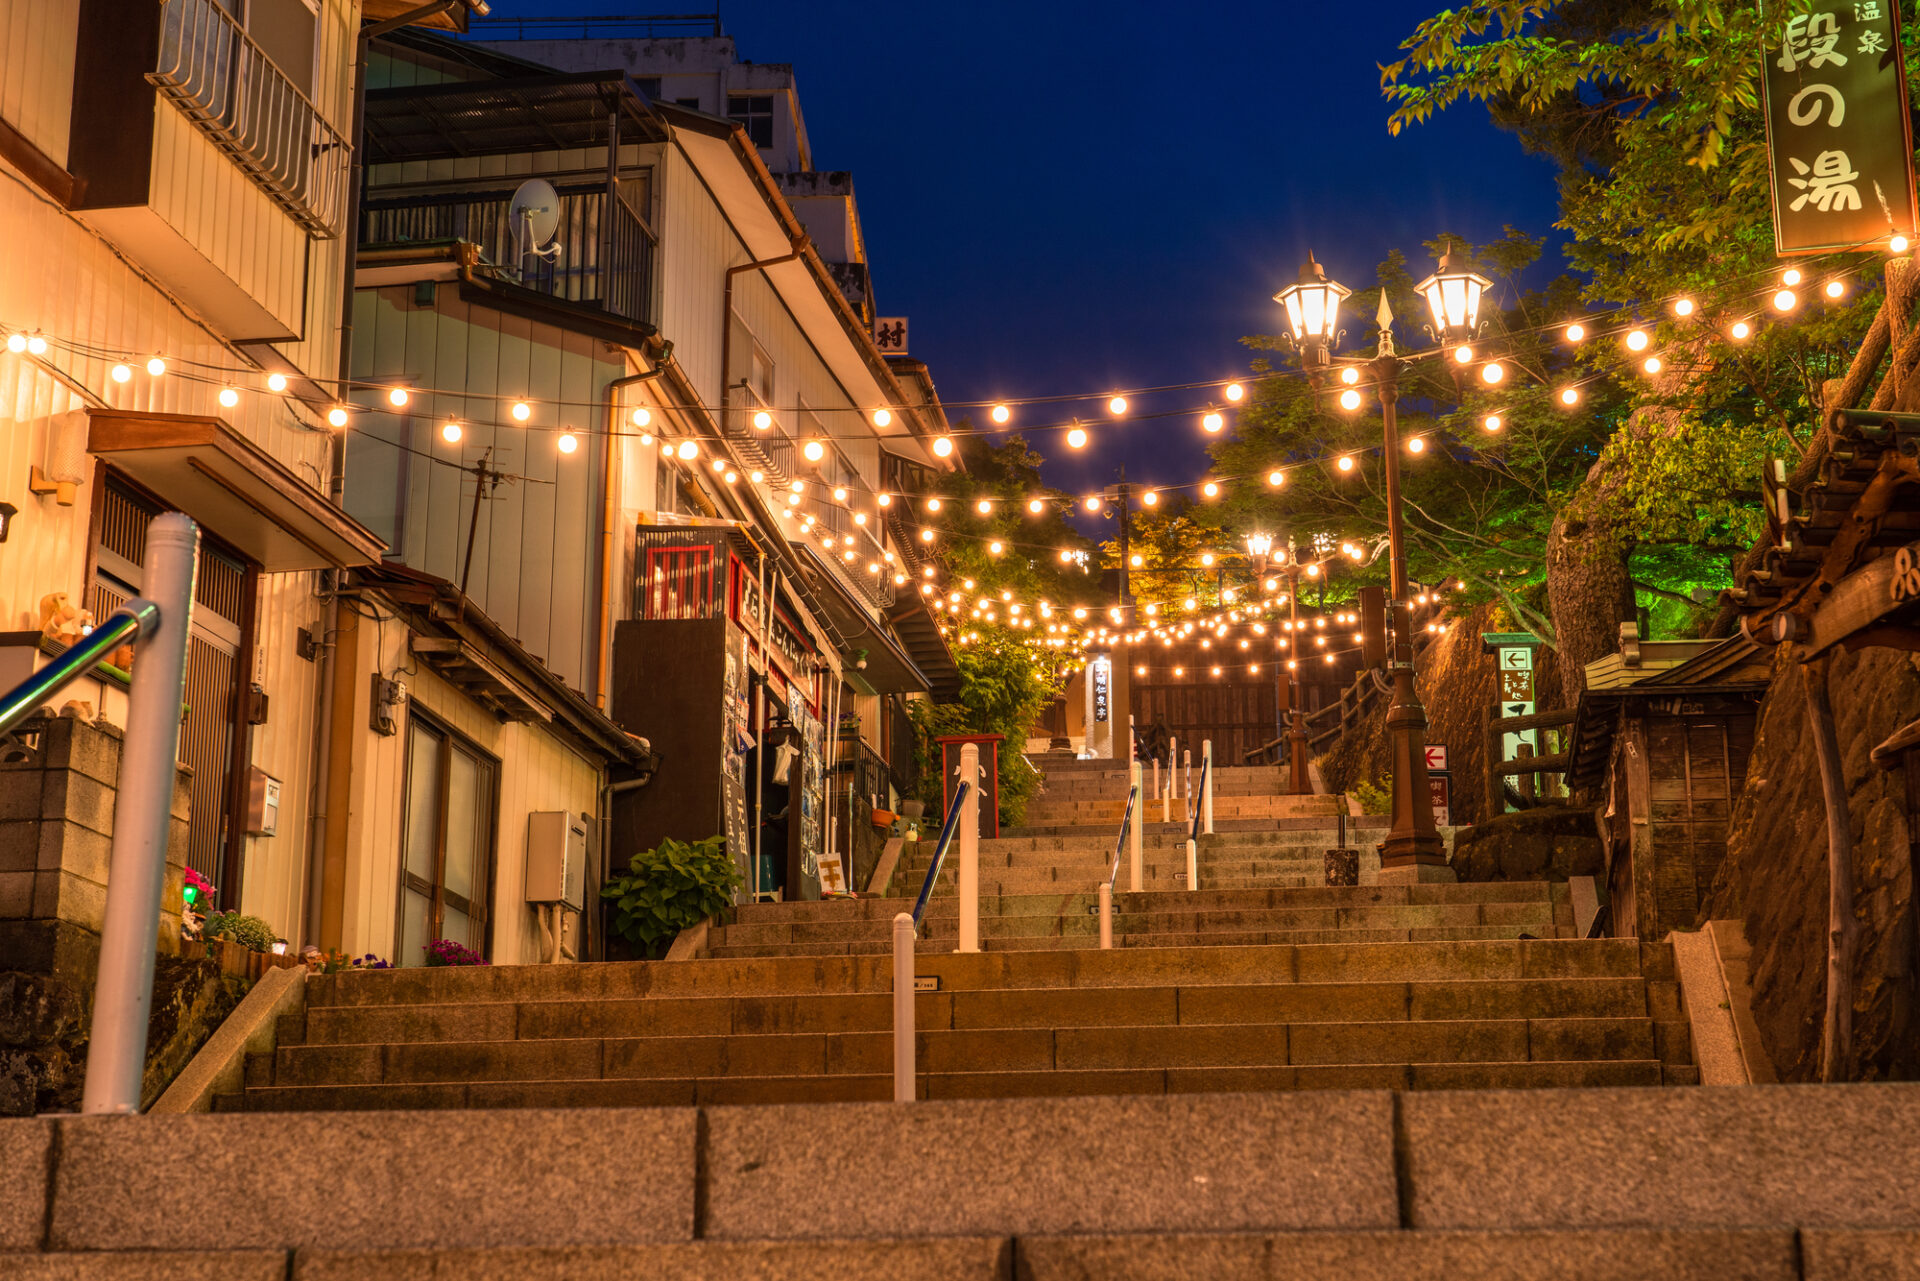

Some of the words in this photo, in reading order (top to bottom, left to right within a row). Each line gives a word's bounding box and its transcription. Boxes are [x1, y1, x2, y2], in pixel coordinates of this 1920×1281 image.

[1853, 1, 1888, 54] 温泉
[1776, 11, 1863, 213] 段の湯
[877, 320, 906, 348] 村
[736, 798, 748, 857] 元祖
